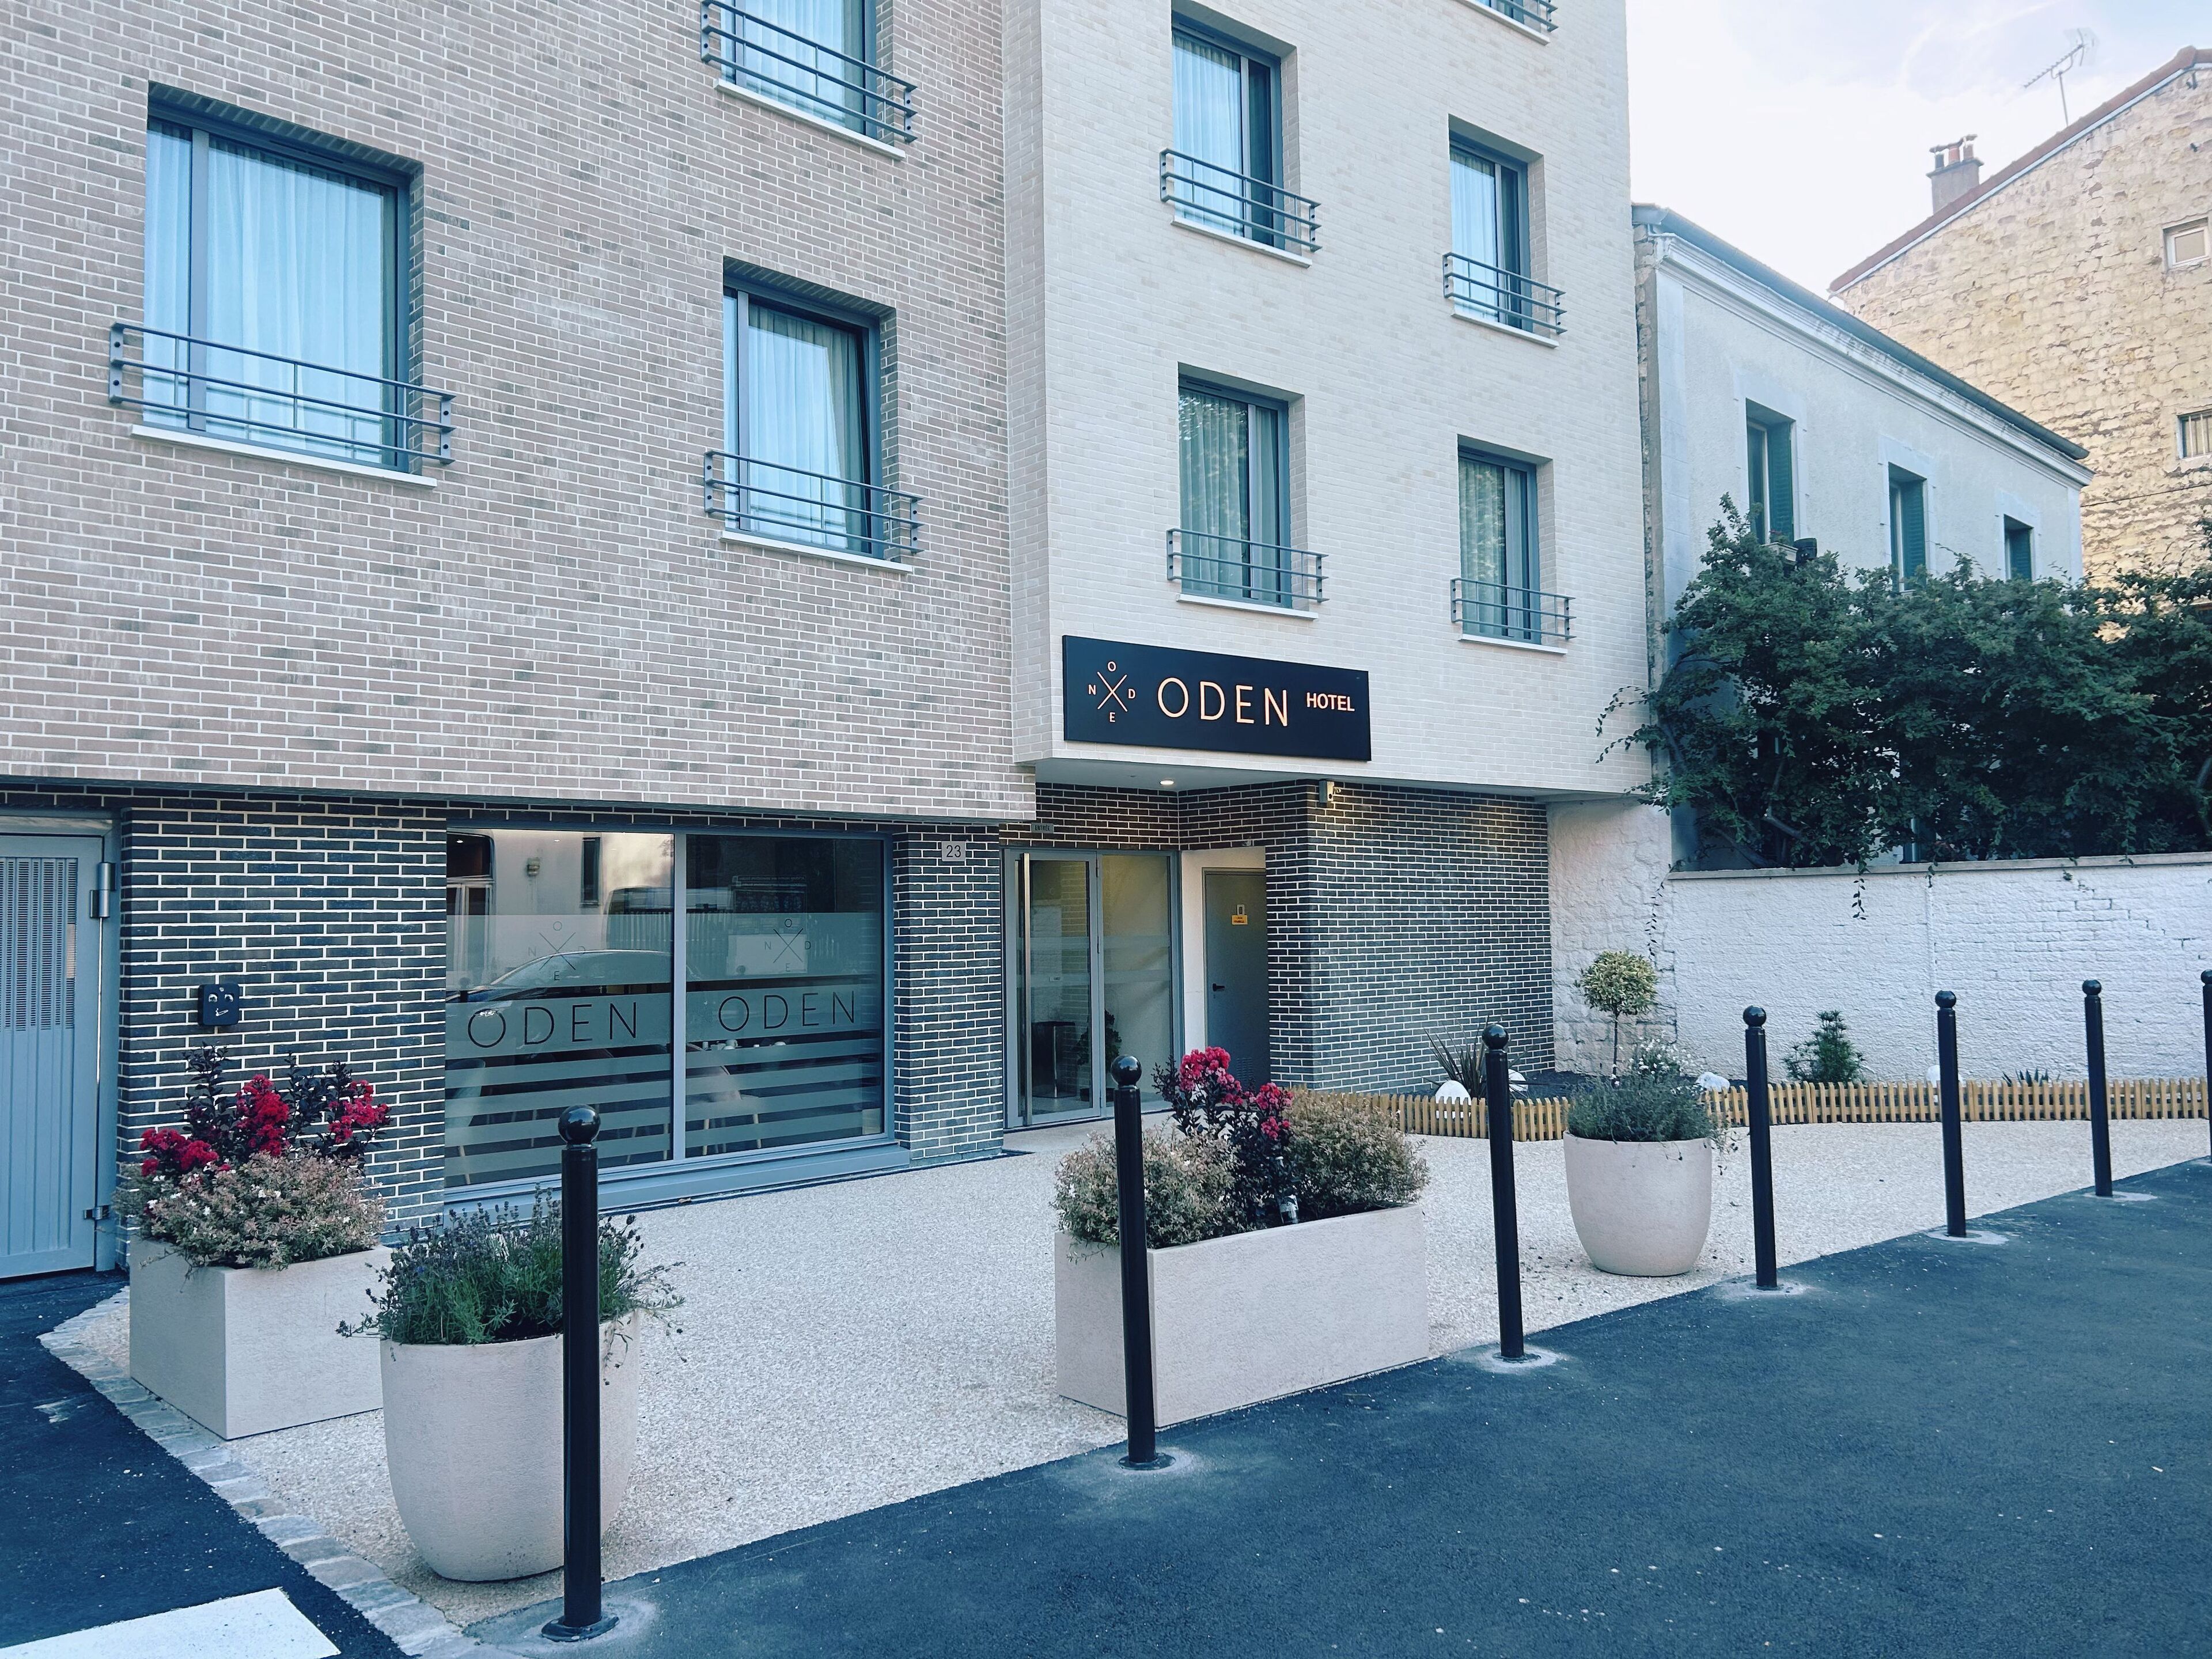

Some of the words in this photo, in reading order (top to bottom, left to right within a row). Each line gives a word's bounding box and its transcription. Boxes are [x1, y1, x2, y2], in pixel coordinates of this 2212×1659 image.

[1107, 661, 1117, 672] O
[1088, 684, 1097, 695] N
[1128, 688, 1136, 699] D
[1157, 677, 1289, 726] ODEN
[1306, 691, 1355, 712] HOTEL
[1109, 712, 1116, 723] E
[946, 844, 961, 858] 23
[784, 918, 792, 927] O
[764, 941, 771, 950] N
[805, 941, 811, 950] D
[785, 963, 791, 972] E
[554, 971, 560, 980] E
[718, 990, 855, 1032] ODEN
[467, 1002, 637, 1048] ODEN
